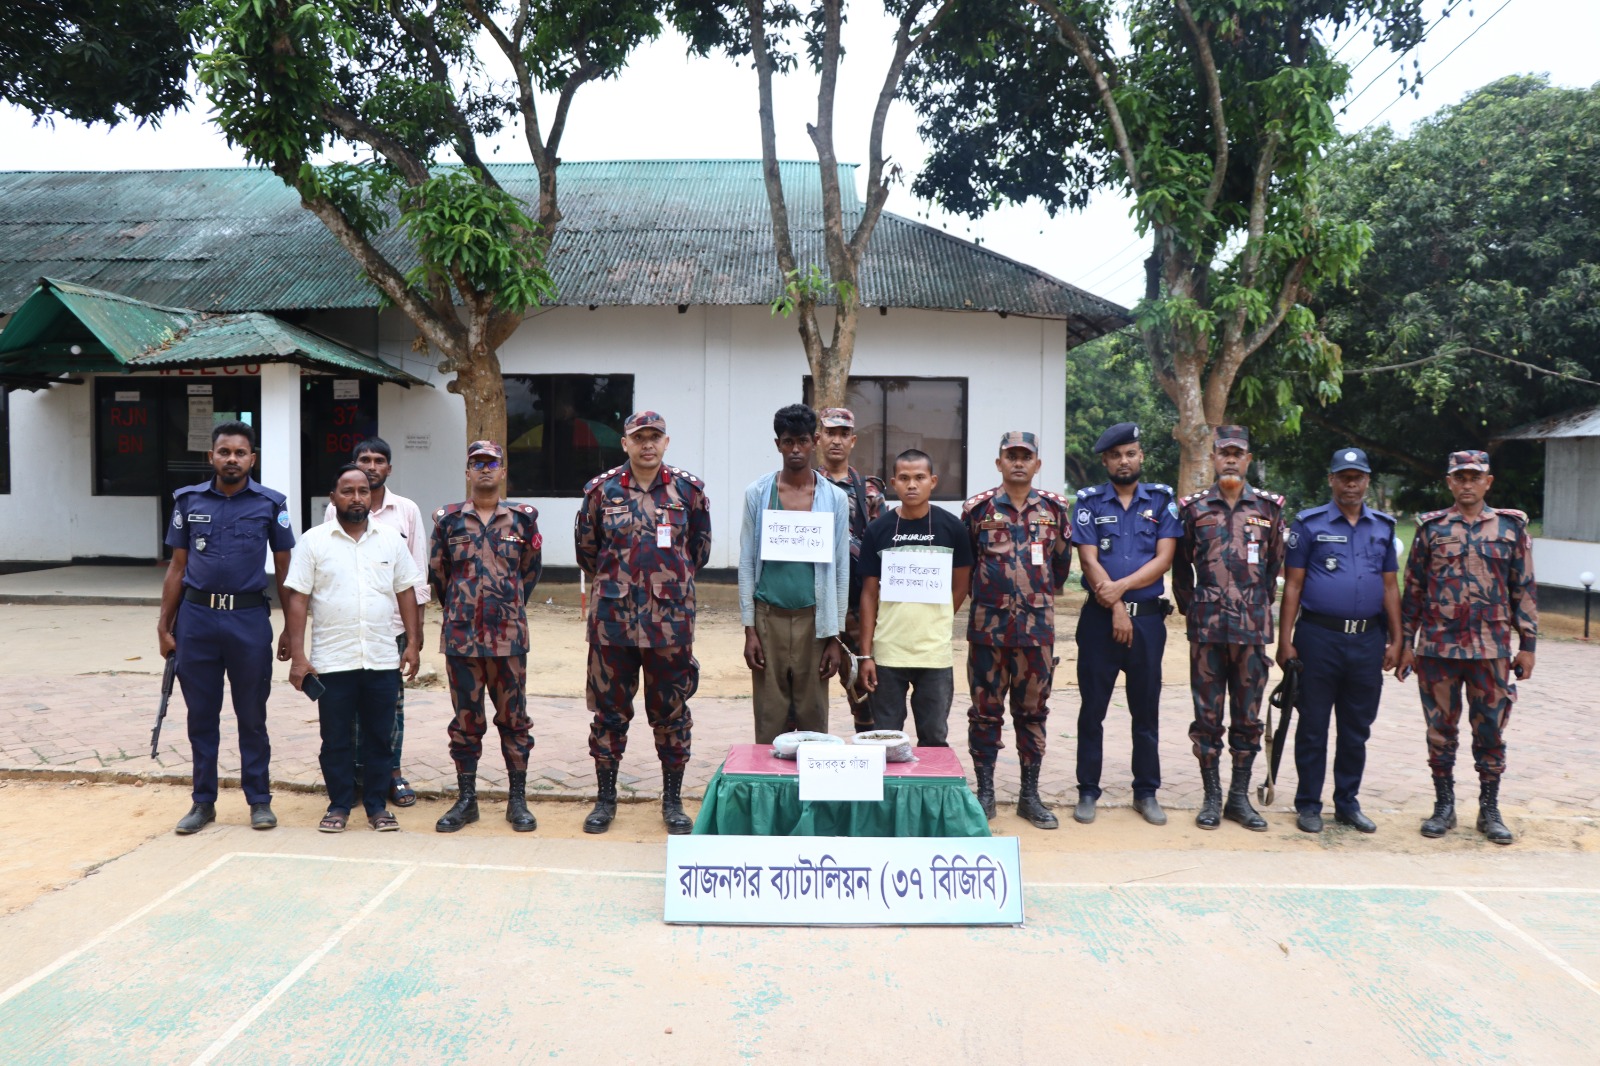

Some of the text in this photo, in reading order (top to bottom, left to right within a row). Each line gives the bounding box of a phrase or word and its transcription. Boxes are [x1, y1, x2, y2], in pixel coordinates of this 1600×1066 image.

[111, 407, 147, 426] RJN
[333, 406, 359, 426] 37
[118, 435, 144, 453] BN
[768, 522, 791, 534] গাঁজা
[888, 563, 906, 574] গাঁজা
[849, 756, 870, 770] গাঁজা
[678, 854, 1008, 909] রাজনগর ব্যাটালিয়ন (৩৭ বিজিবি)
